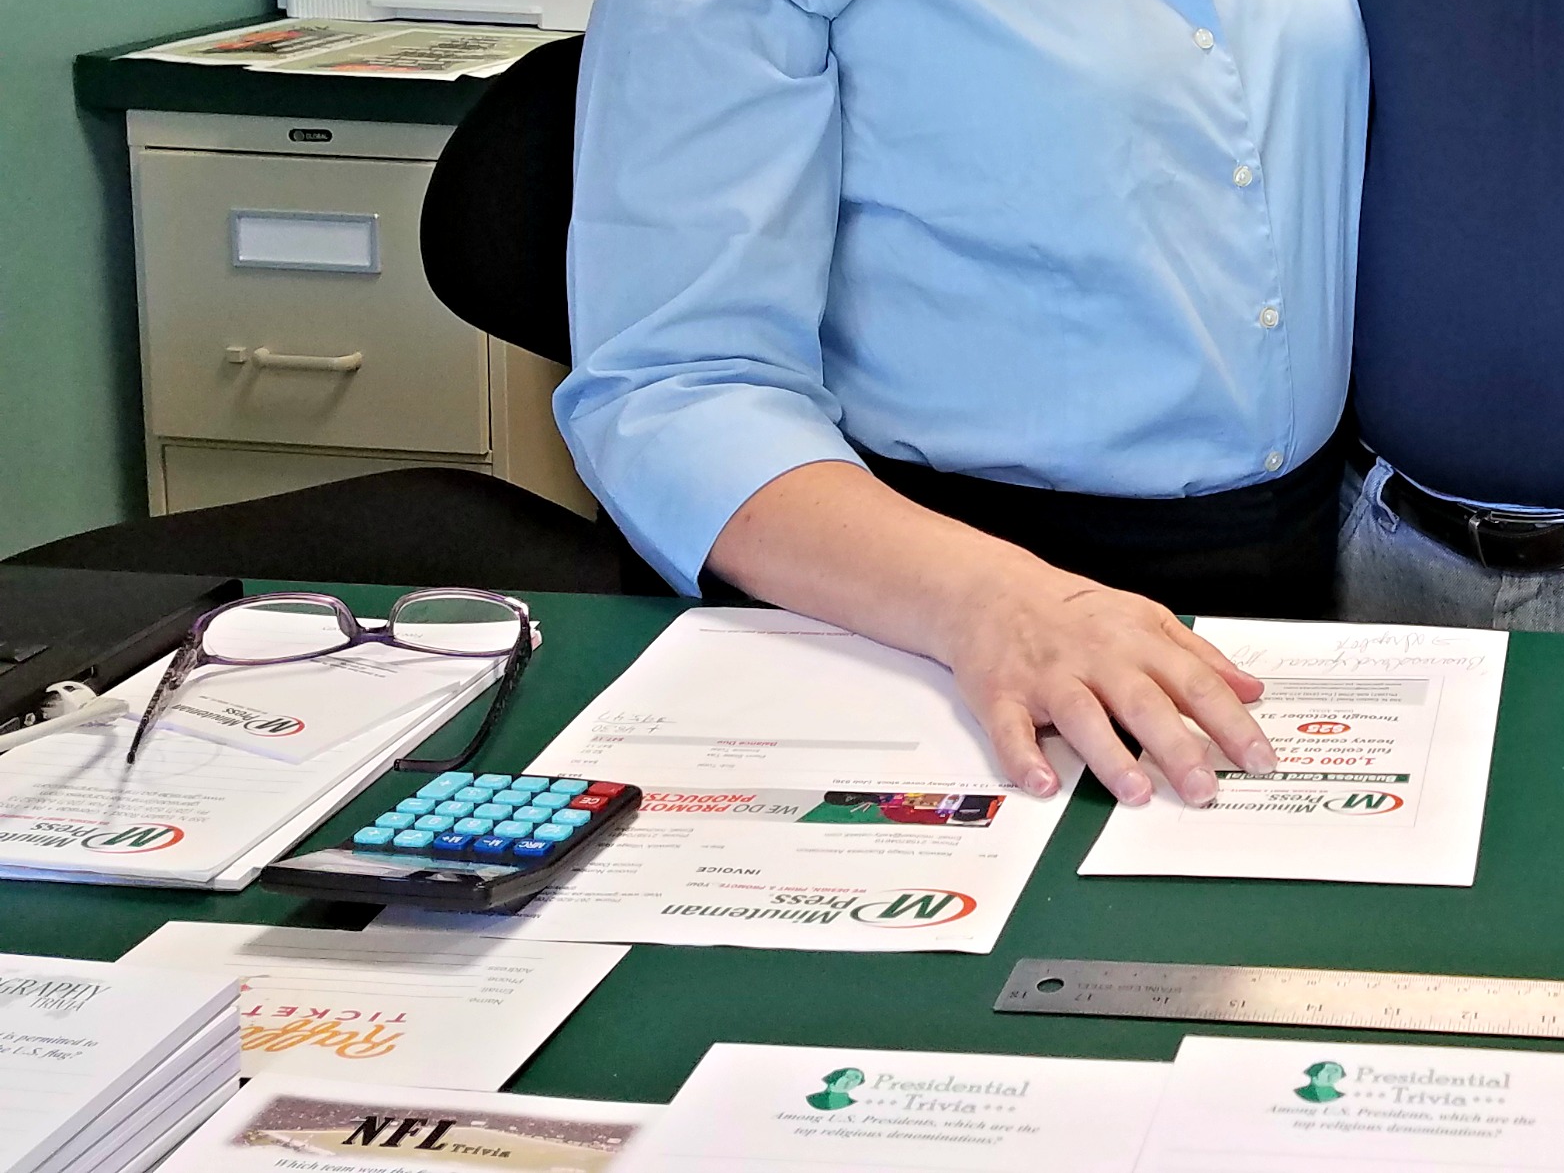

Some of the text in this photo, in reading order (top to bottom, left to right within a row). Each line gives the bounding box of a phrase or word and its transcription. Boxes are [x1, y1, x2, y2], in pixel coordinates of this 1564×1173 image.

[1341, 714, 1400, 722] Through
[1306, 724, 1346, 733] $25
[1320, 757, 1376, 765] 1,000
[1285, 773, 1324, 781] Card
[1327, 773, 1397, 783] Business
[579, 797, 601, 806] CE
[733, 804, 766, 813] DO
[765, 805, 799, 815] WE
[519, 840, 546, 849] MRC
[695, 865, 762, 876] INVOICE
[659, 904, 842, 925] Minuteman
[1074, 993, 1093, 1001] 17
[1152, 996, 1169, 1004] 16
[30, 997, 85, 1011] TRIVIA
[1229, 1000, 1246, 1008] 15
[1306, 1003, 1324, 1012] 14
[241, 1005, 407, 1023] TICKET
[1383, 1007, 1401, 1016] 13
[1460, 1011, 1479, 1019] 12
[1540, 1015, 1557, 1023] 11
[13, 1035, 86, 1044] permitted
[38, 1049, 83, 1060] flag?
[1354, 1066, 1510, 1089] Presidential
[870, 1073, 1031, 1098] Presidential
[1390, 1087, 1468, 1106] Trivia
[902, 1093, 977, 1114] Trivia
[1267, 1105, 1536, 1126] Among U.S. Presidents, which are the
[775, 1112, 824, 1124] Among
[828, 1114, 856, 1124] U.S.
[863, 1115, 937, 1128] Presidents,
[944, 1120, 986, 1131] which
[1017, 1124, 1041, 1134] the
[1292, 1120, 1502, 1138] top religious denominations?
[341, 1115, 512, 1159] NFL Trivia
[793, 1127, 1004, 1146] top religious denominations?
[274, 1158, 355, 1173] Which team
